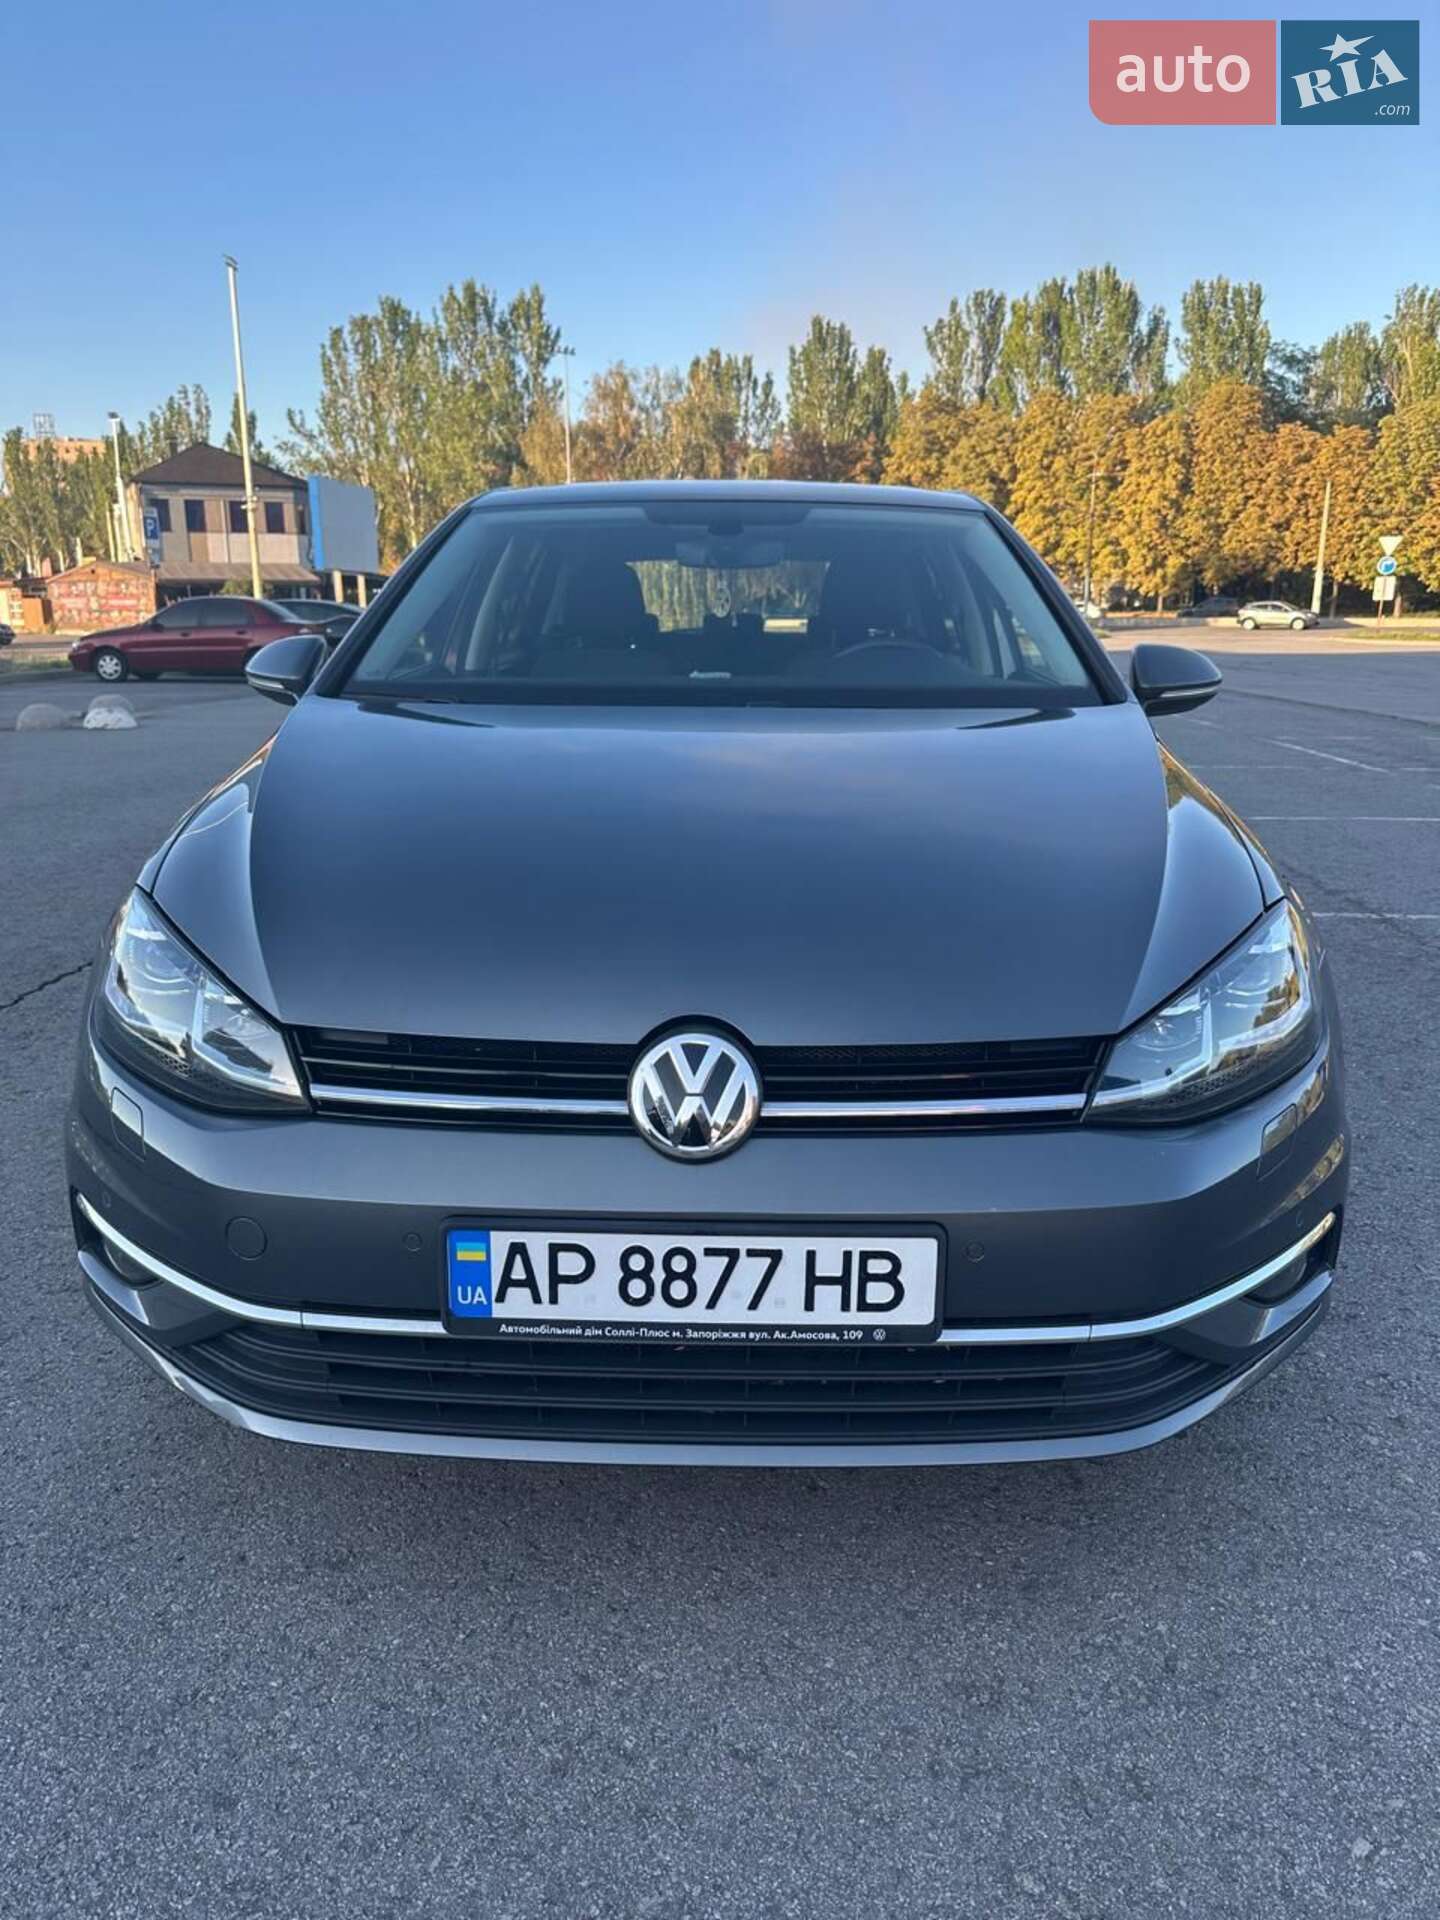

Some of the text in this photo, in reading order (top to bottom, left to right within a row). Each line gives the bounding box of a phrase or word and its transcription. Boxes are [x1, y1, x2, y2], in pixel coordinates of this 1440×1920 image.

[494, 1242, 905, 1312] AP 8877 HB
[457, 1285, 487, 1305] UA
[499, 1323, 582, 1336] Автомобільний
[604, 1326, 670, 1338] Соллі-Плюс
[685, 1328, 746, 1340] Запоріжжя
[748, 1331, 769, 1341] вул.
[842, 1330, 863, 1340] 109
